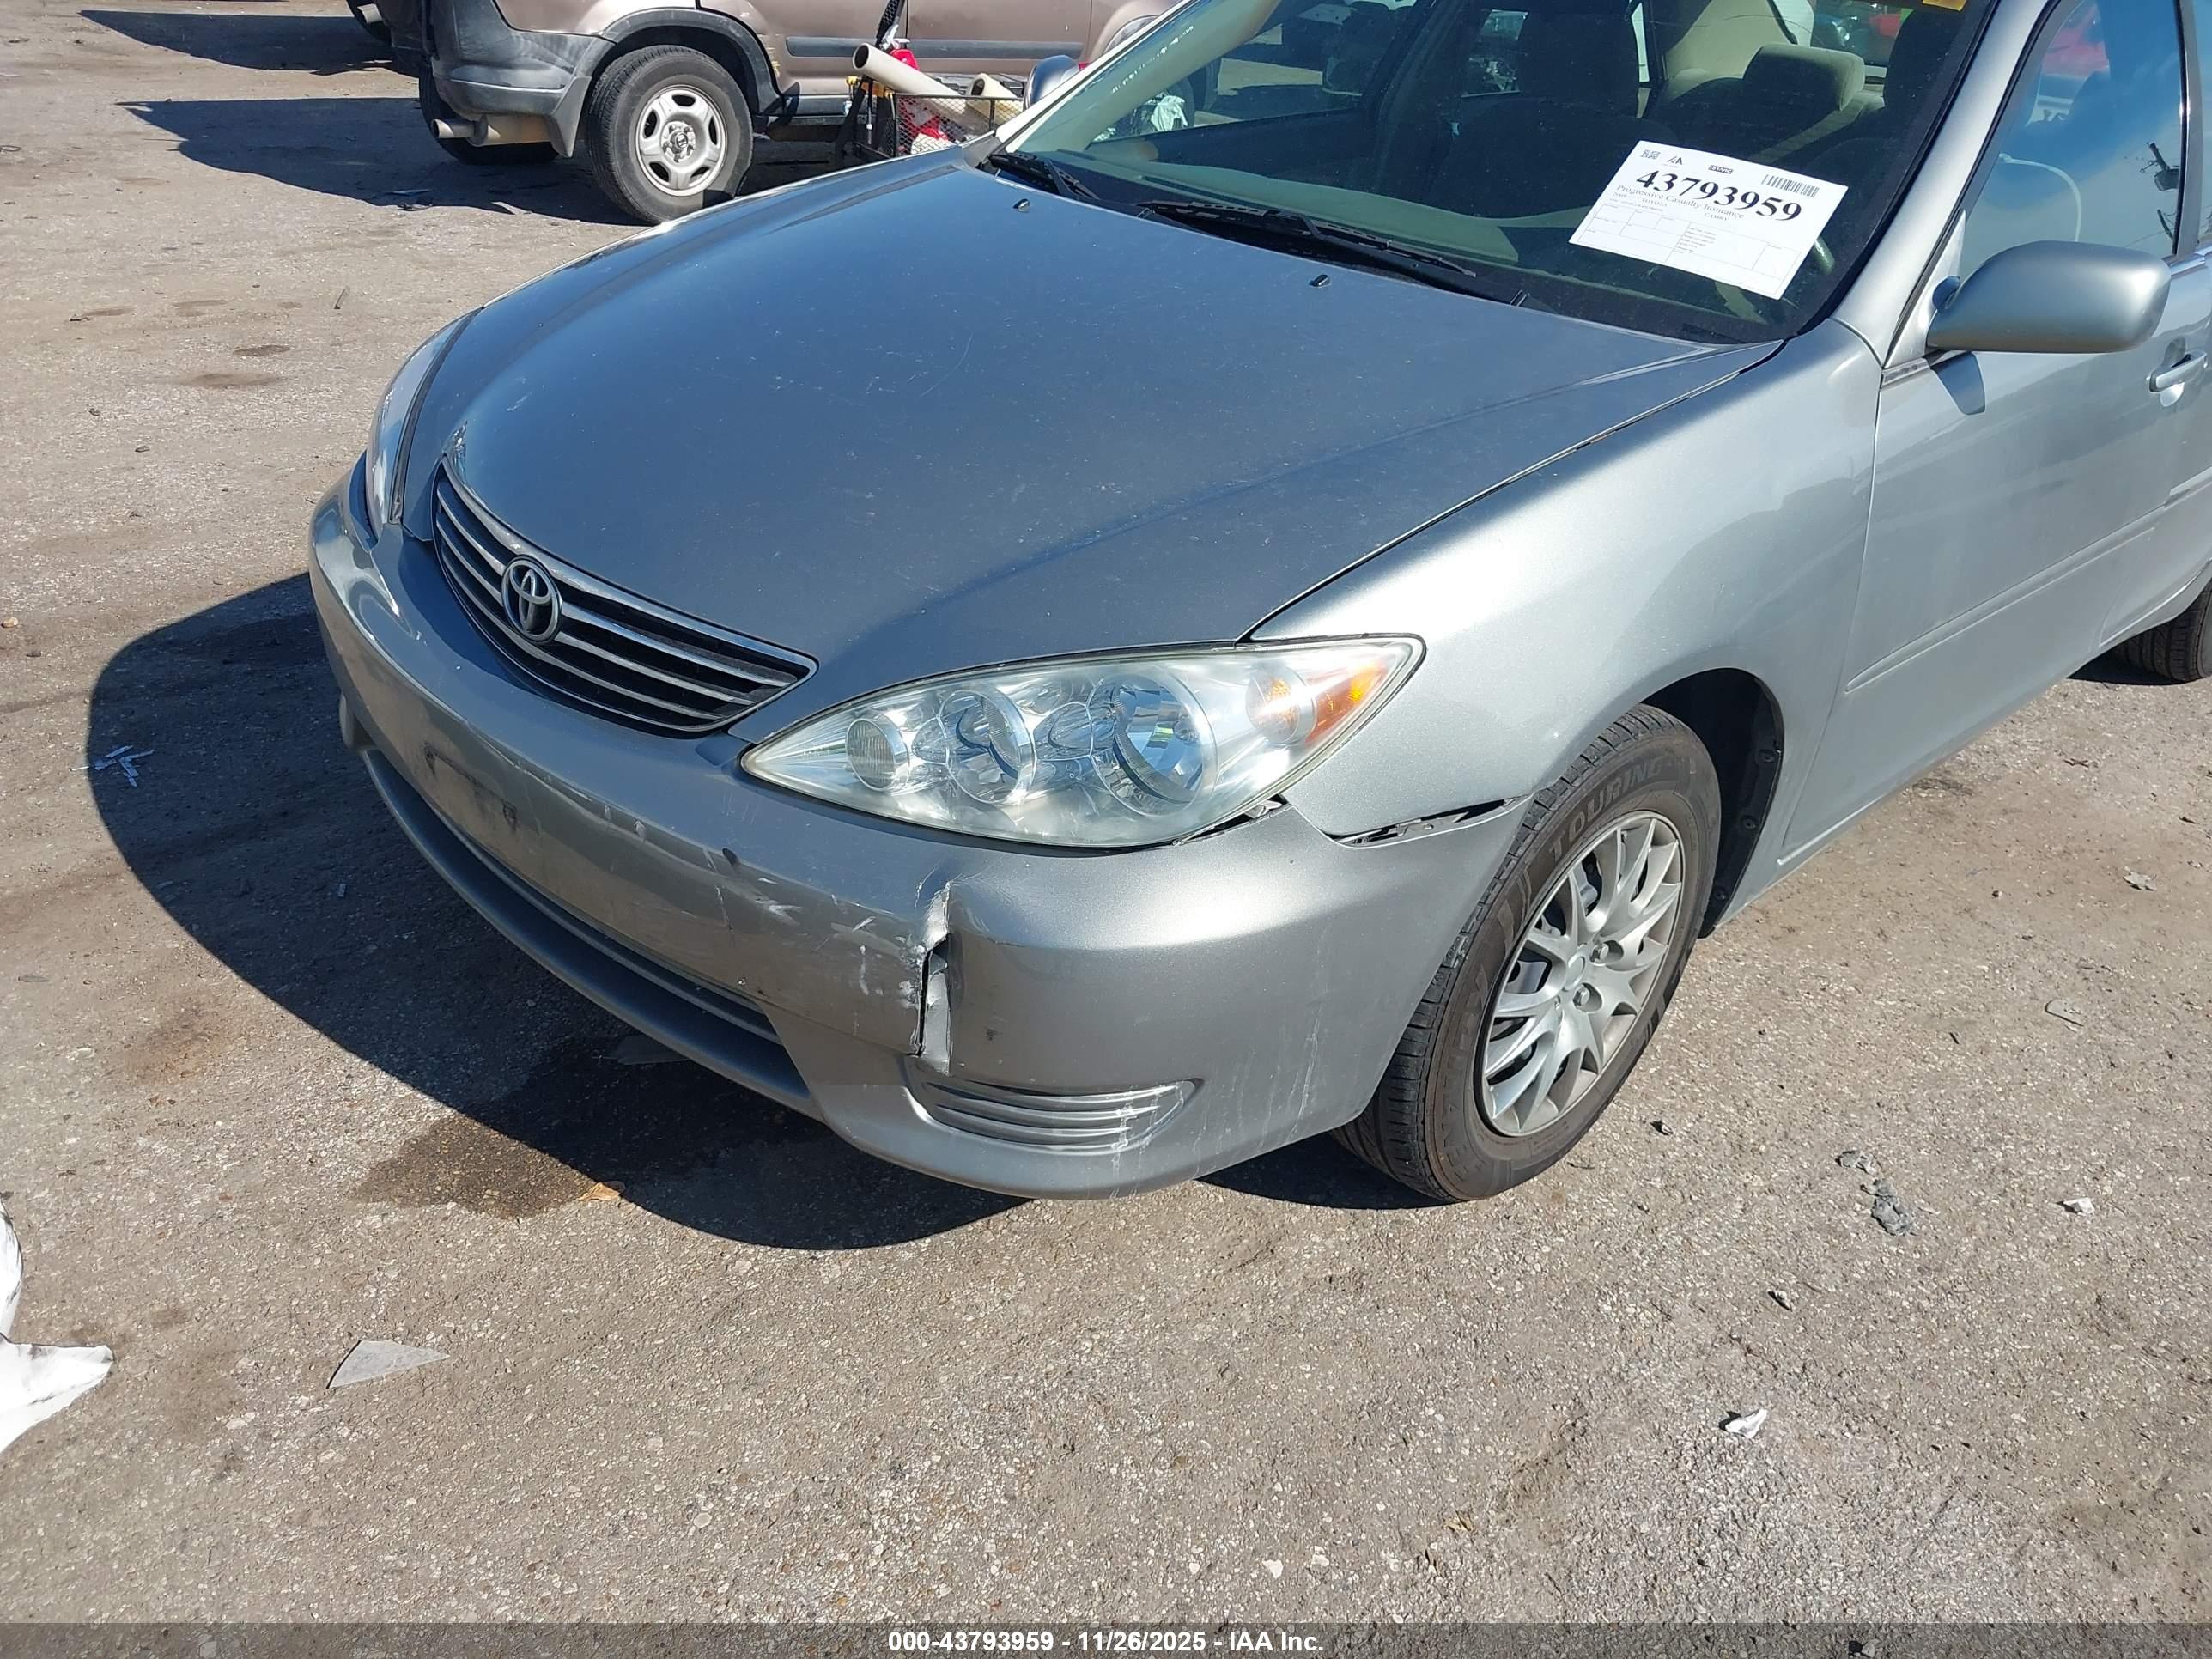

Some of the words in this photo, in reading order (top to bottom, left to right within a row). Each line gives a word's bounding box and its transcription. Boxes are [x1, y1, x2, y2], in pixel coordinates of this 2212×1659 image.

[1617, 185, 1664, 199] Progressive
[1666, 195, 1700, 209] Casualty
[1703, 204, 1745, 219] Insurance
[1636, 170, 1802, 221] 43793959
[1549, 755, 1663, 862] TOURING
